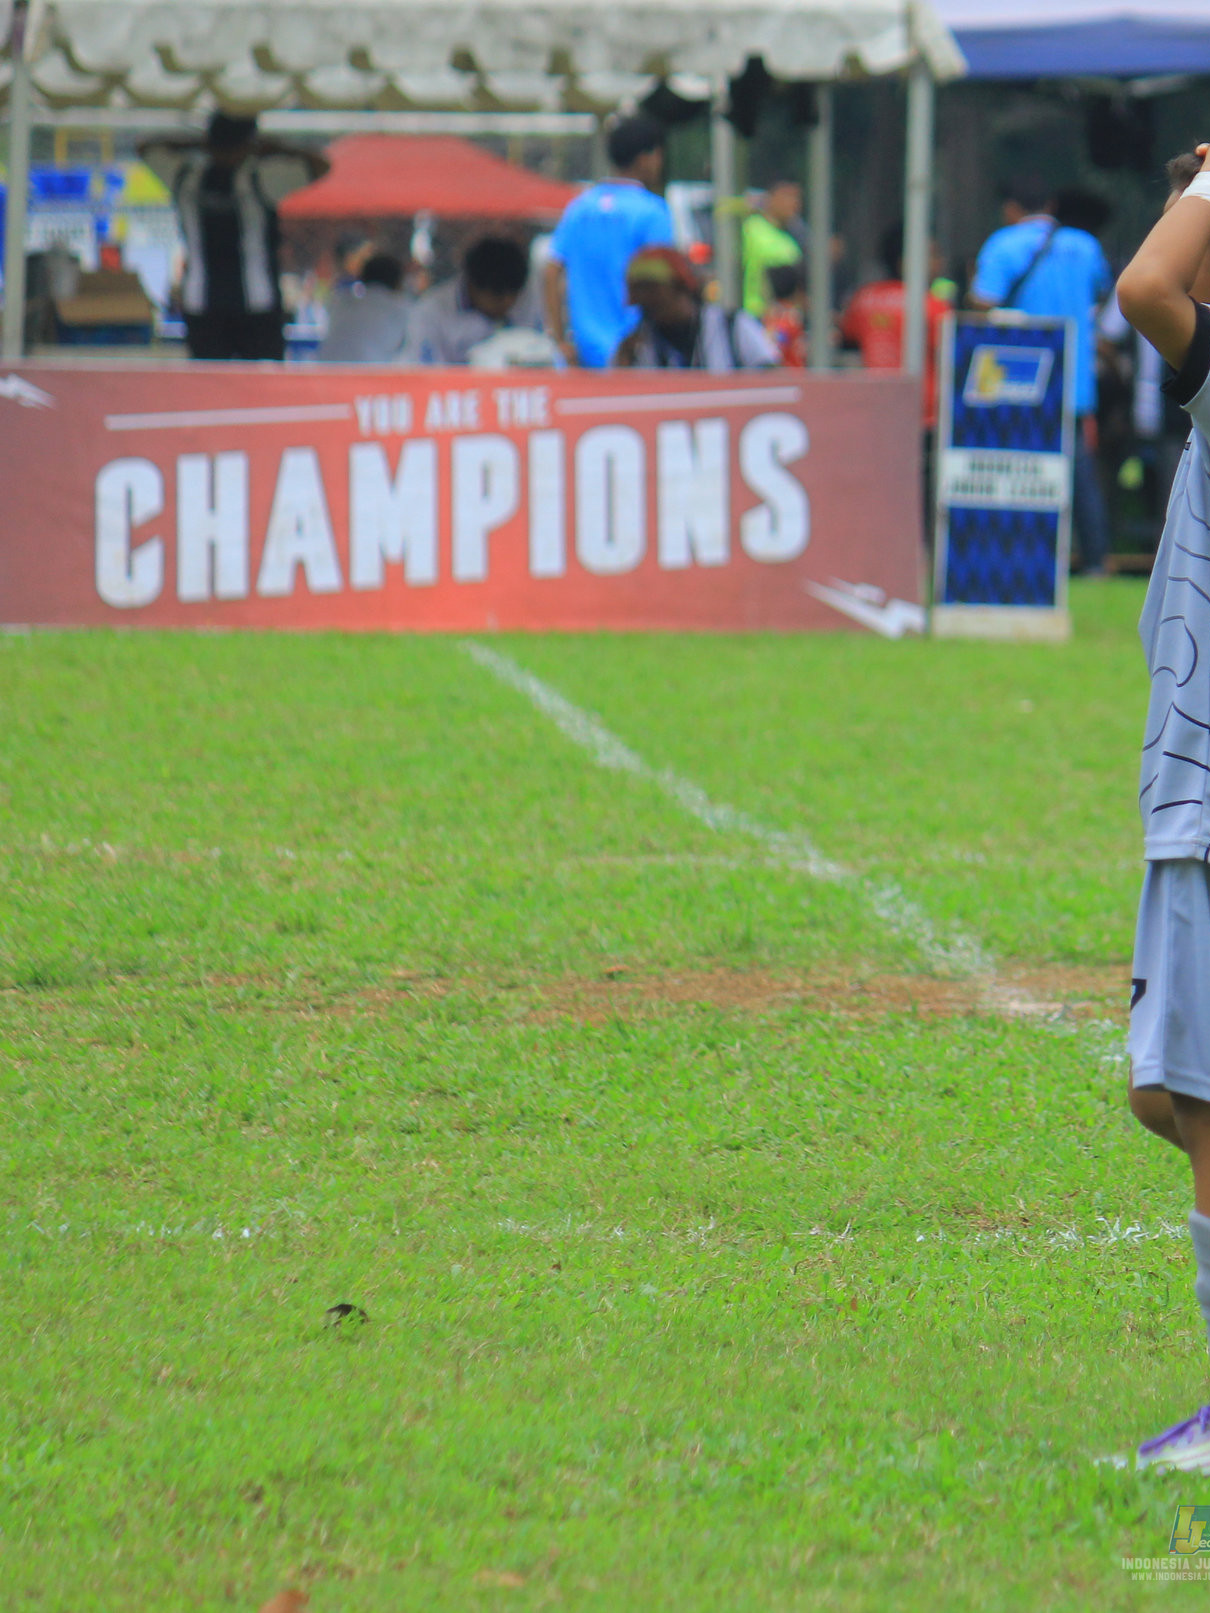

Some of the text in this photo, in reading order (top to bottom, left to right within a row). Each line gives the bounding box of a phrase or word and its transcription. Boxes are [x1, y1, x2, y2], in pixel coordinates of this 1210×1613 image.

[355, 385, 552, 437] YOU ARE THE
[95, 411, 811, 609] CHAMPIONS
